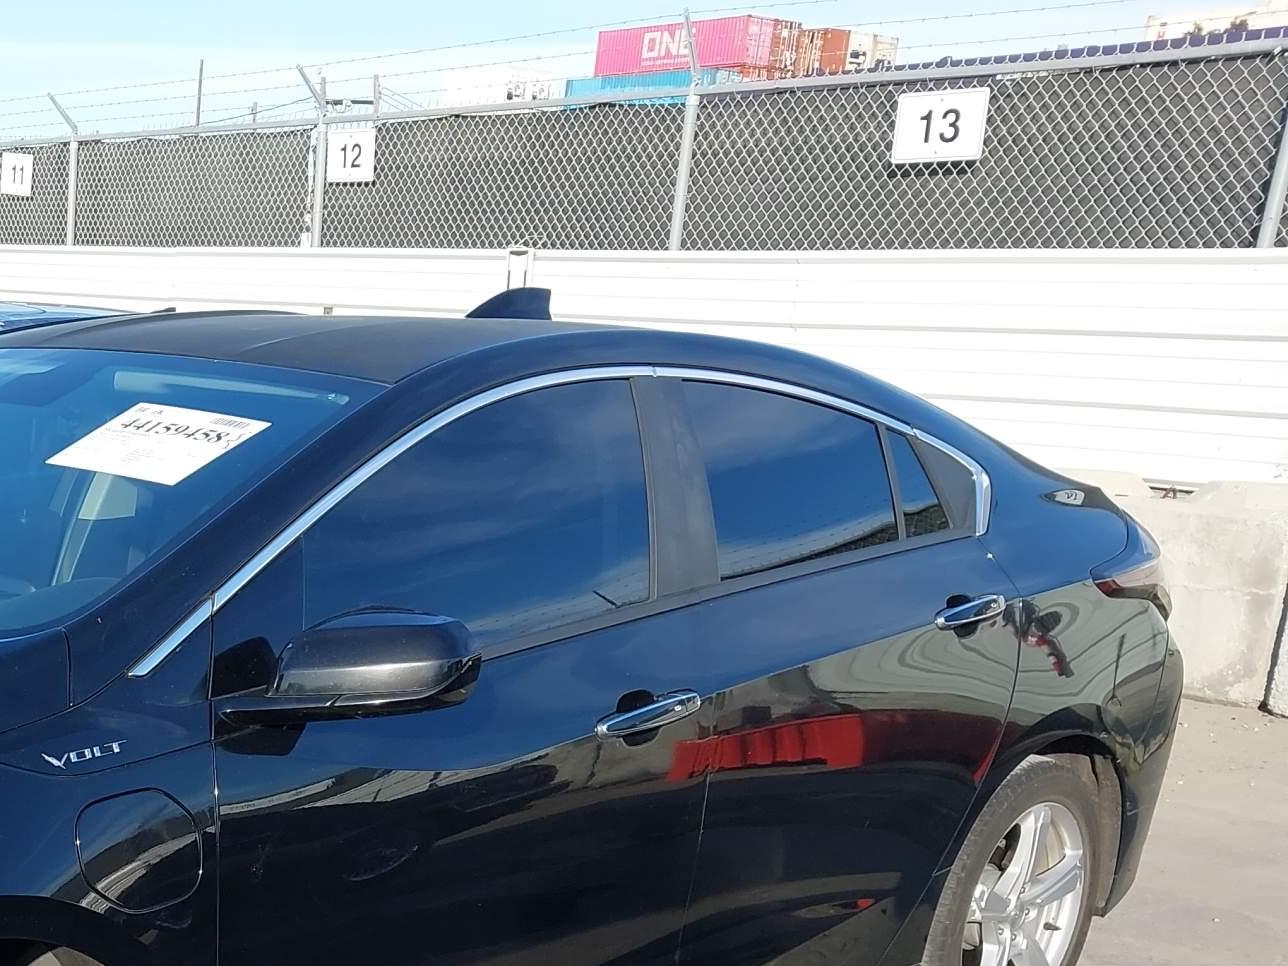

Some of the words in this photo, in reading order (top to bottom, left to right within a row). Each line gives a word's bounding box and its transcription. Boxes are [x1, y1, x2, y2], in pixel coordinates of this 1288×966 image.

[920, 108, 960, 143] 13
[340, 143, 362, 168] 12
[11, 163, 24, 185] 11
[121, 418, 230, 443] 44159458
[40, 739, 128, 770] VOLT
